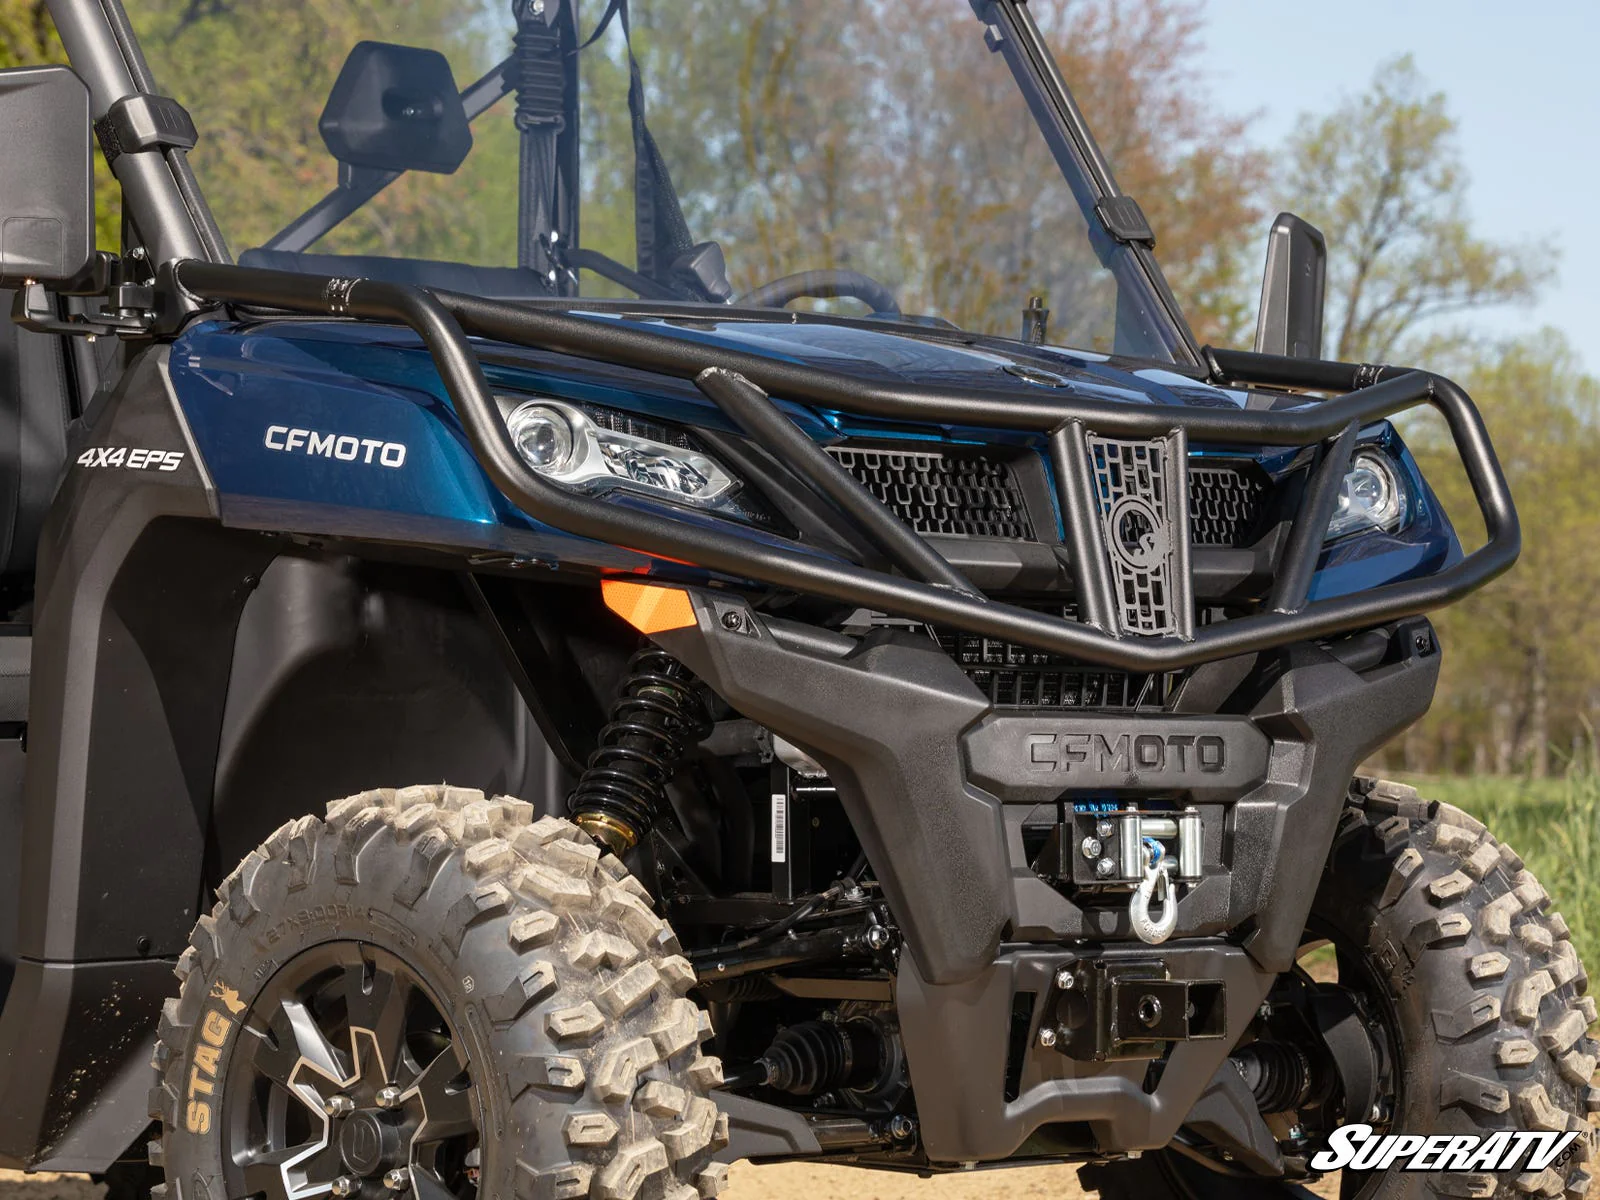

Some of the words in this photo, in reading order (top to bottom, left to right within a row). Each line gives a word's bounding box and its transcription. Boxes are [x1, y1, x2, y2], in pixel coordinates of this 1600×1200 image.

[76, 447, 127, 468] 4X4
[126, 448, 185, 471] EPS
[264, 425, 407, 468] CFMOTO
[1024, 733, 1226, 773] CFMOTO
[186, 1010, 233, 1135] STAG
